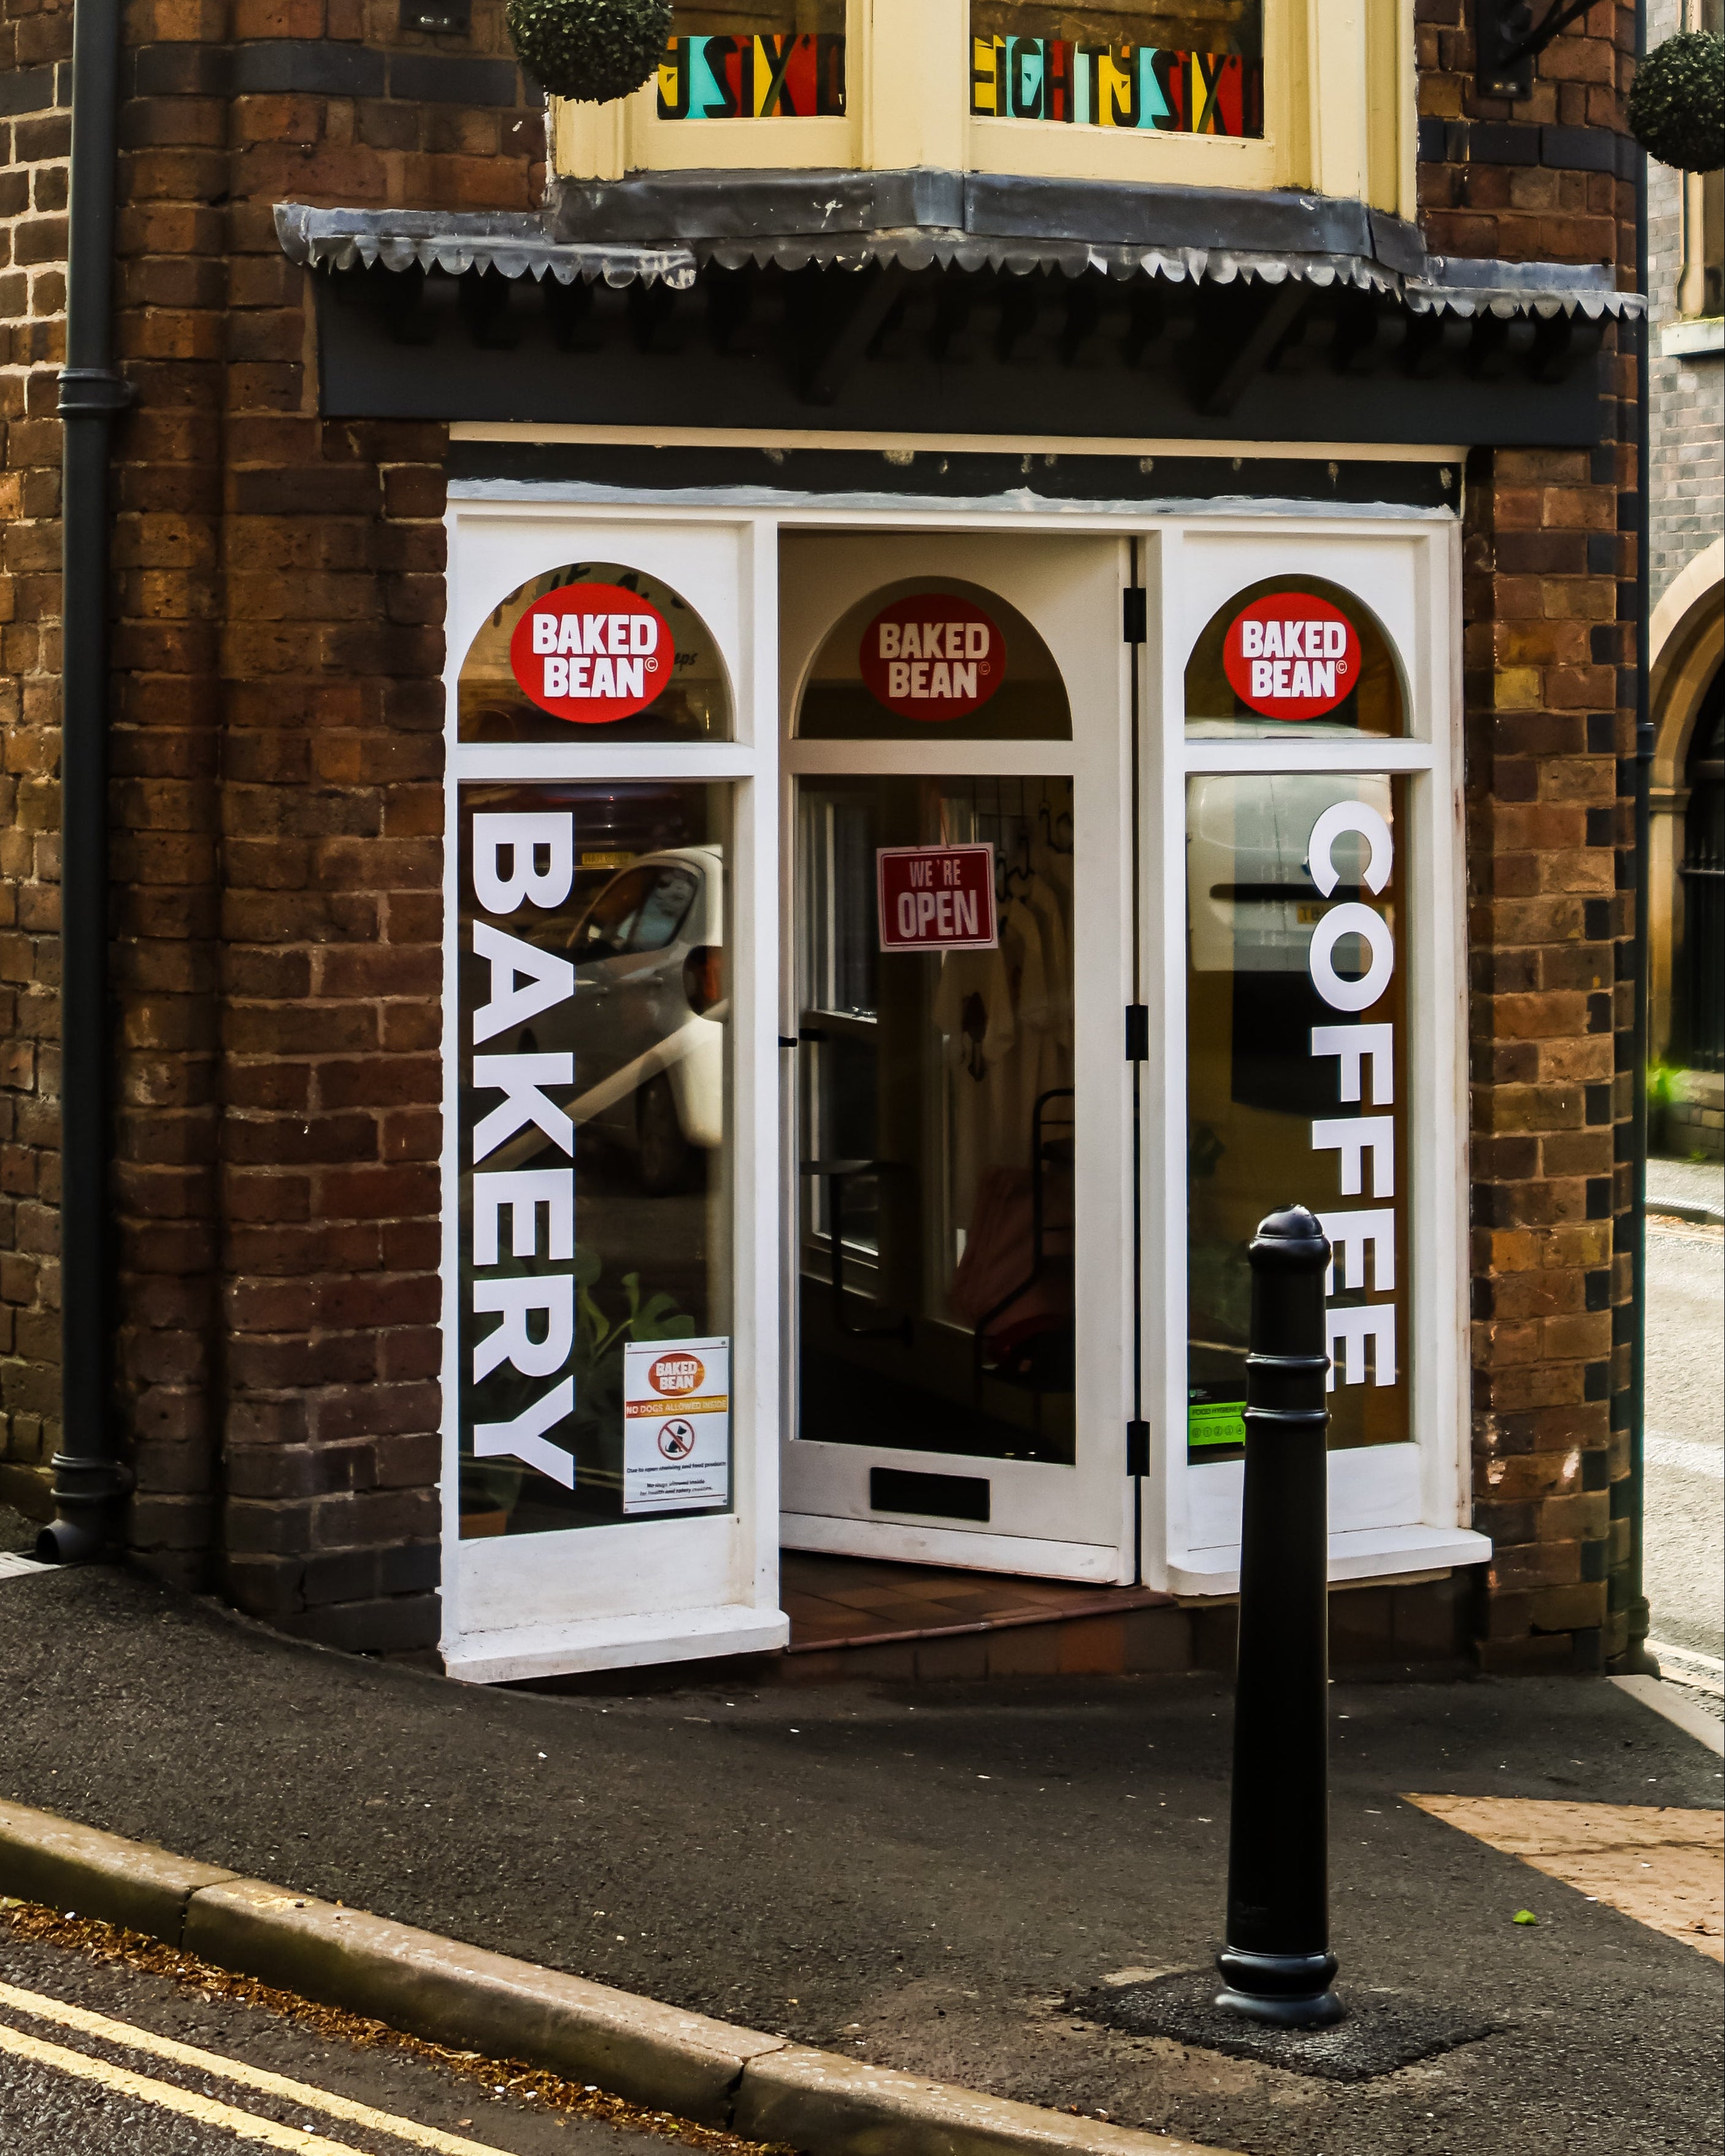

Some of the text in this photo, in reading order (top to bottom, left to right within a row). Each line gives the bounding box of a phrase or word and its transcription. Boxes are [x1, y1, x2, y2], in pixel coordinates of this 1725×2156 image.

[533, 613, 658, 655] BAKED
[879, 623, 989, 659] BAKED
[1242, 621, 1347, 658] BAKED
[910, 859, 961, 888] WE'RE
[897, 889, 979, 938] OPEN
[1308, 800, 1396, 1392] COFFEE
[473, 812, 575, 1490] BAKERY
[656, 1361, 697, 1376] BAKED
[659, 1375, 694, 1390] BEAN
[626, 1406, 639, 1414] NO
[640, 1404, 663, 1413] DOGS
[665, 1402, 702, 1411] ALLOWED
